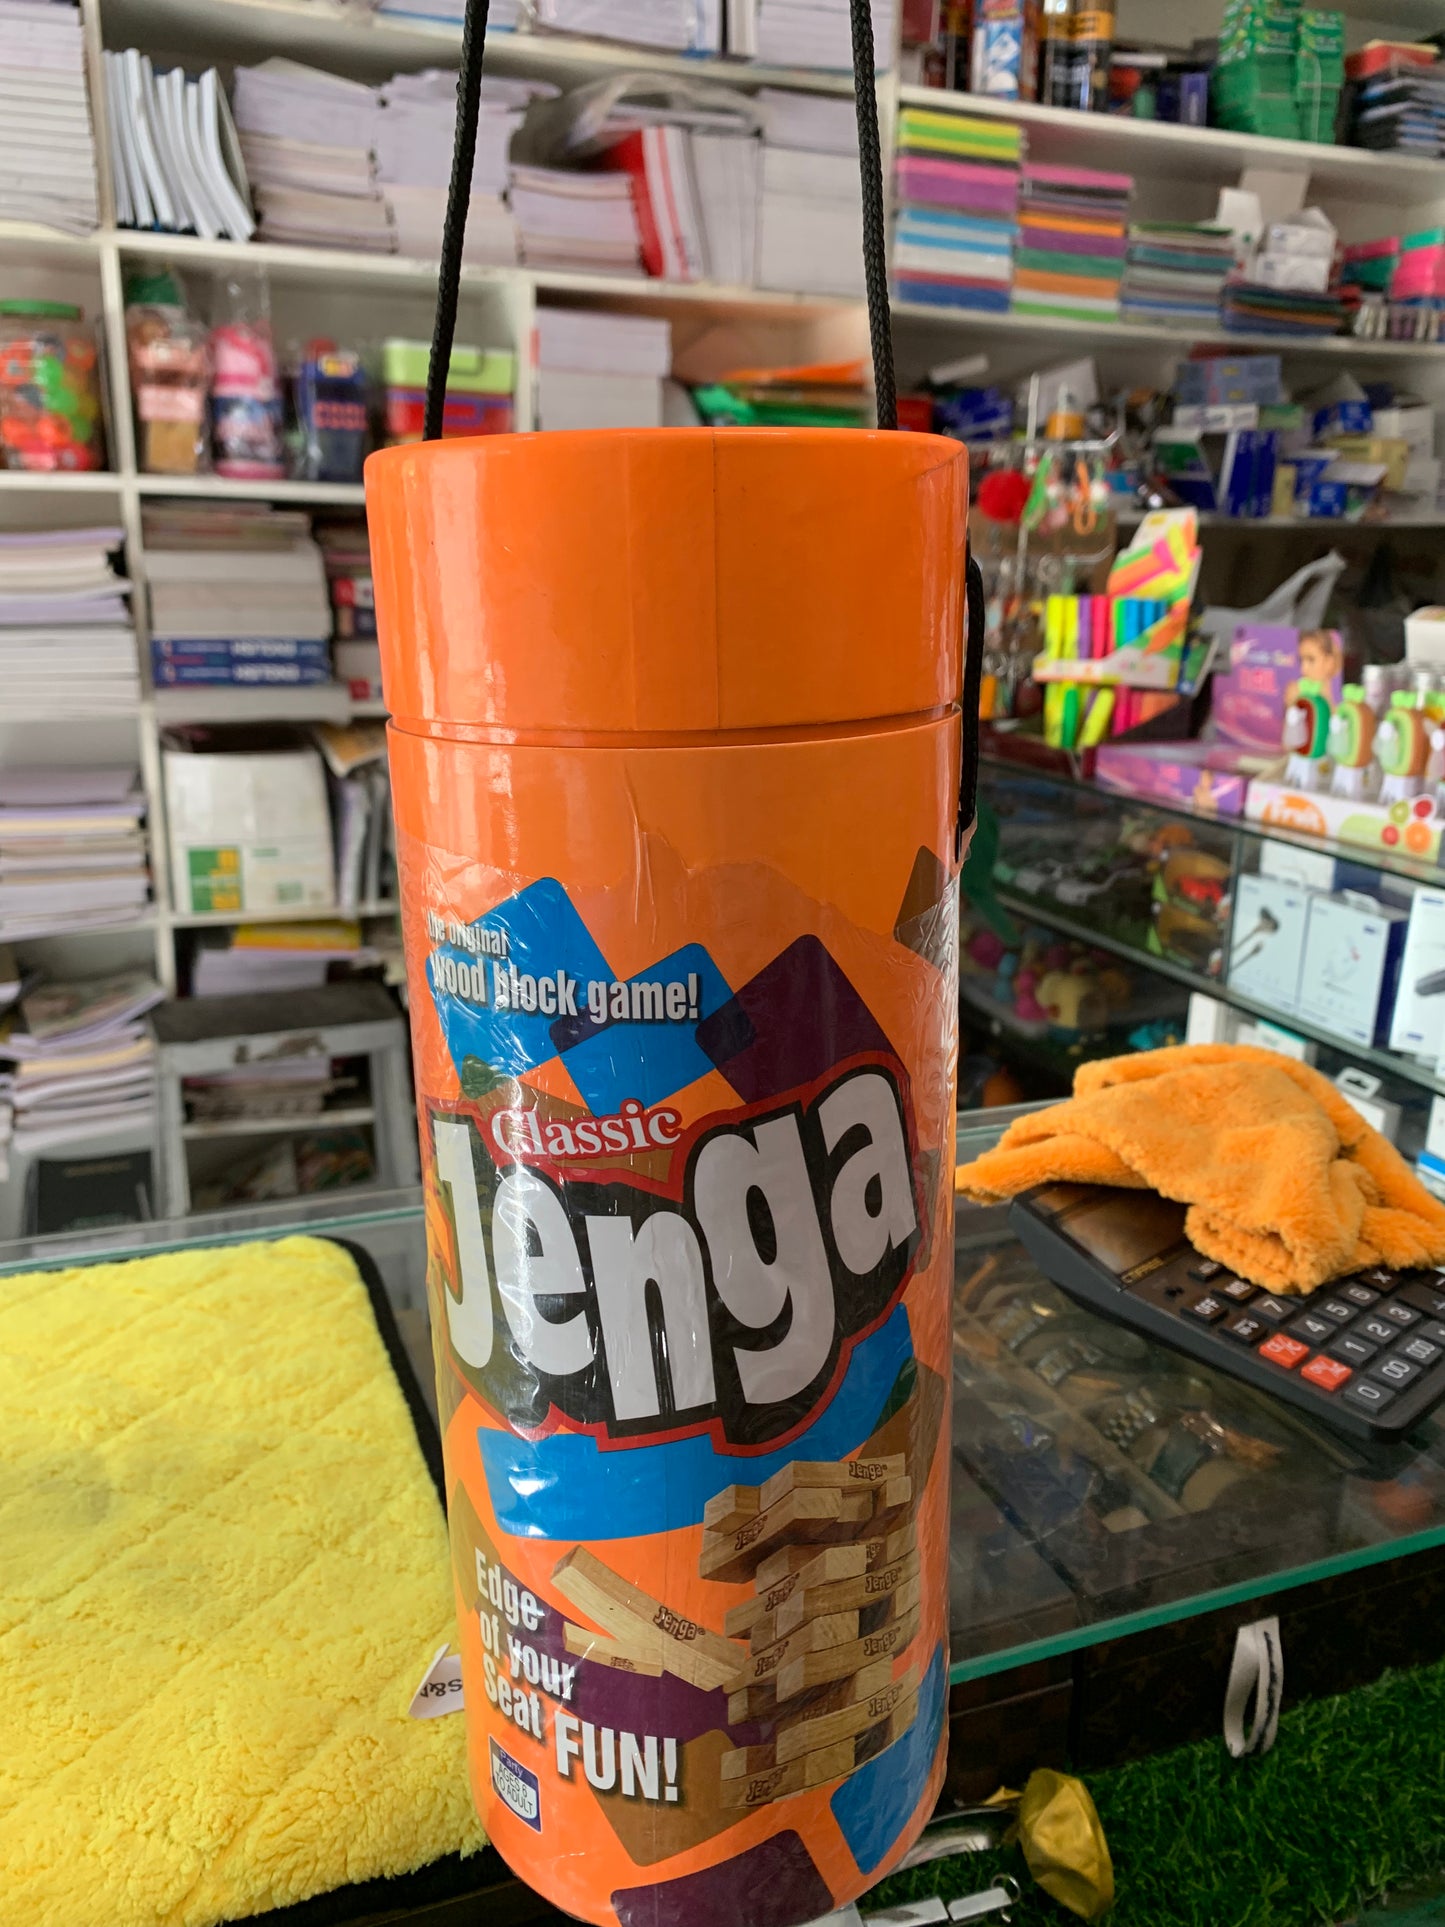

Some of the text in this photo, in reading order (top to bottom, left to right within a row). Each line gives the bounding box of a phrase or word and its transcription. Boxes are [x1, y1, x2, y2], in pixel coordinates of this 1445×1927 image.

[448, 923, 509, 957] original
[493, 961, 578, 1017] block
[587, 972, 699, 1024] game!
[491, 1103, 681, 1156] Classic
[433, 1073, 917, 1421] Jenga
[1262, 1299, 1284, 1313] 7
[1348, 1288, 1371, 1300] 6
[1326, 1303, 1349, 1316] 5
[1389, 1307, 1412, 1320] 3
[1305, 1319, 1327, 1333] 4
[1367, 1322, 1391, 1337] 2
[1344, 1341, 1366, 1353] 1
[1357, 1385, 1381, 1399] 0
[849, 1461, 883, 1480] Jenga
[475, 1547, 540, 1631] Edge
[865, 1570, 899, 1593] Jenga
[653, 1605, 698, 1640] Jenga
[864, 1631, 897, 1656] Jenga
[507, 1635, 576, 1700] your
[482, 1652, 678, 1802] Seat FUN!
[507, 1787, 533, 1815] ADULT
